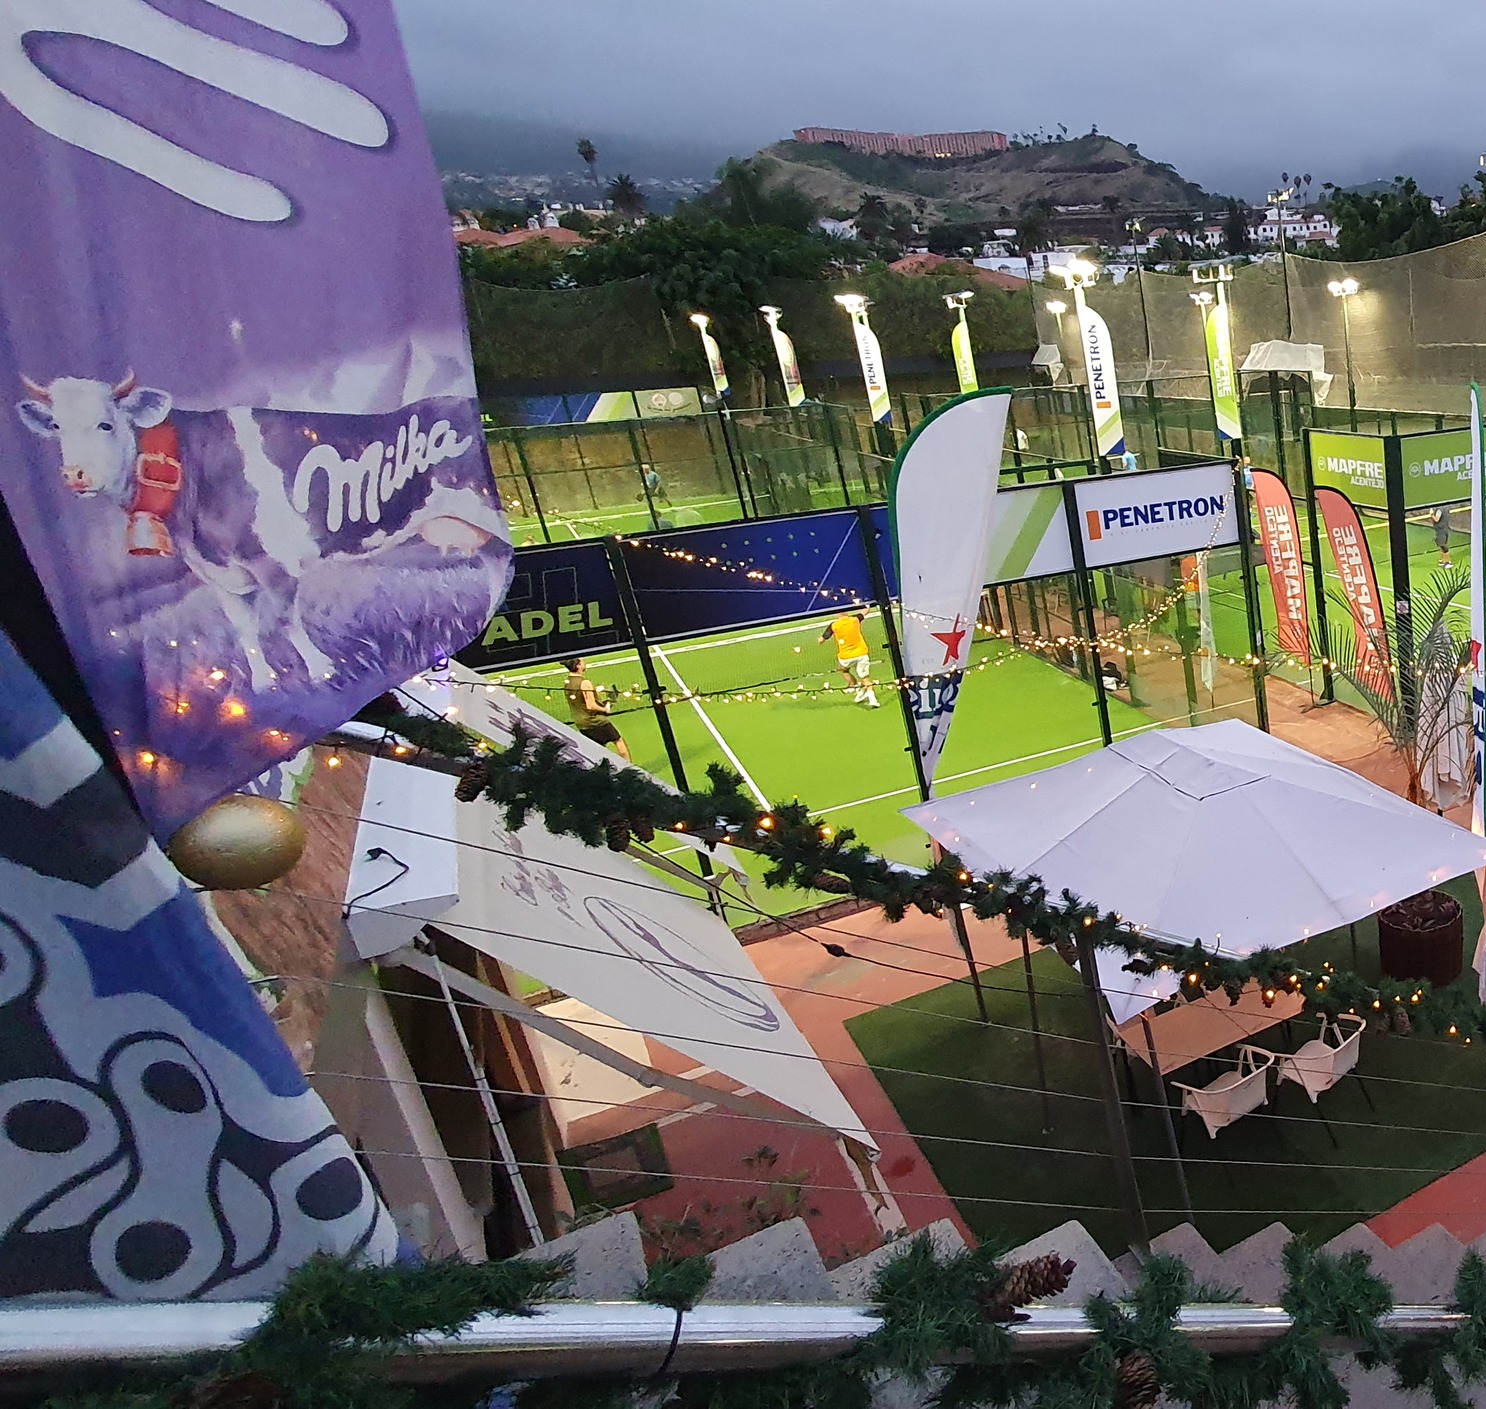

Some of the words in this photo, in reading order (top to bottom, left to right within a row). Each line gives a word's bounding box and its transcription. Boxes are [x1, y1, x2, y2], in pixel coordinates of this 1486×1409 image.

[1087, 323, 1106, 400] PENETRON
[293, 413, 473, 532] Milka
[1327, 456, 1384, 479] MAPFRE
[1102, 494, 1225, 531] PENETRON
[481, 601, 614, 647] ADEL
